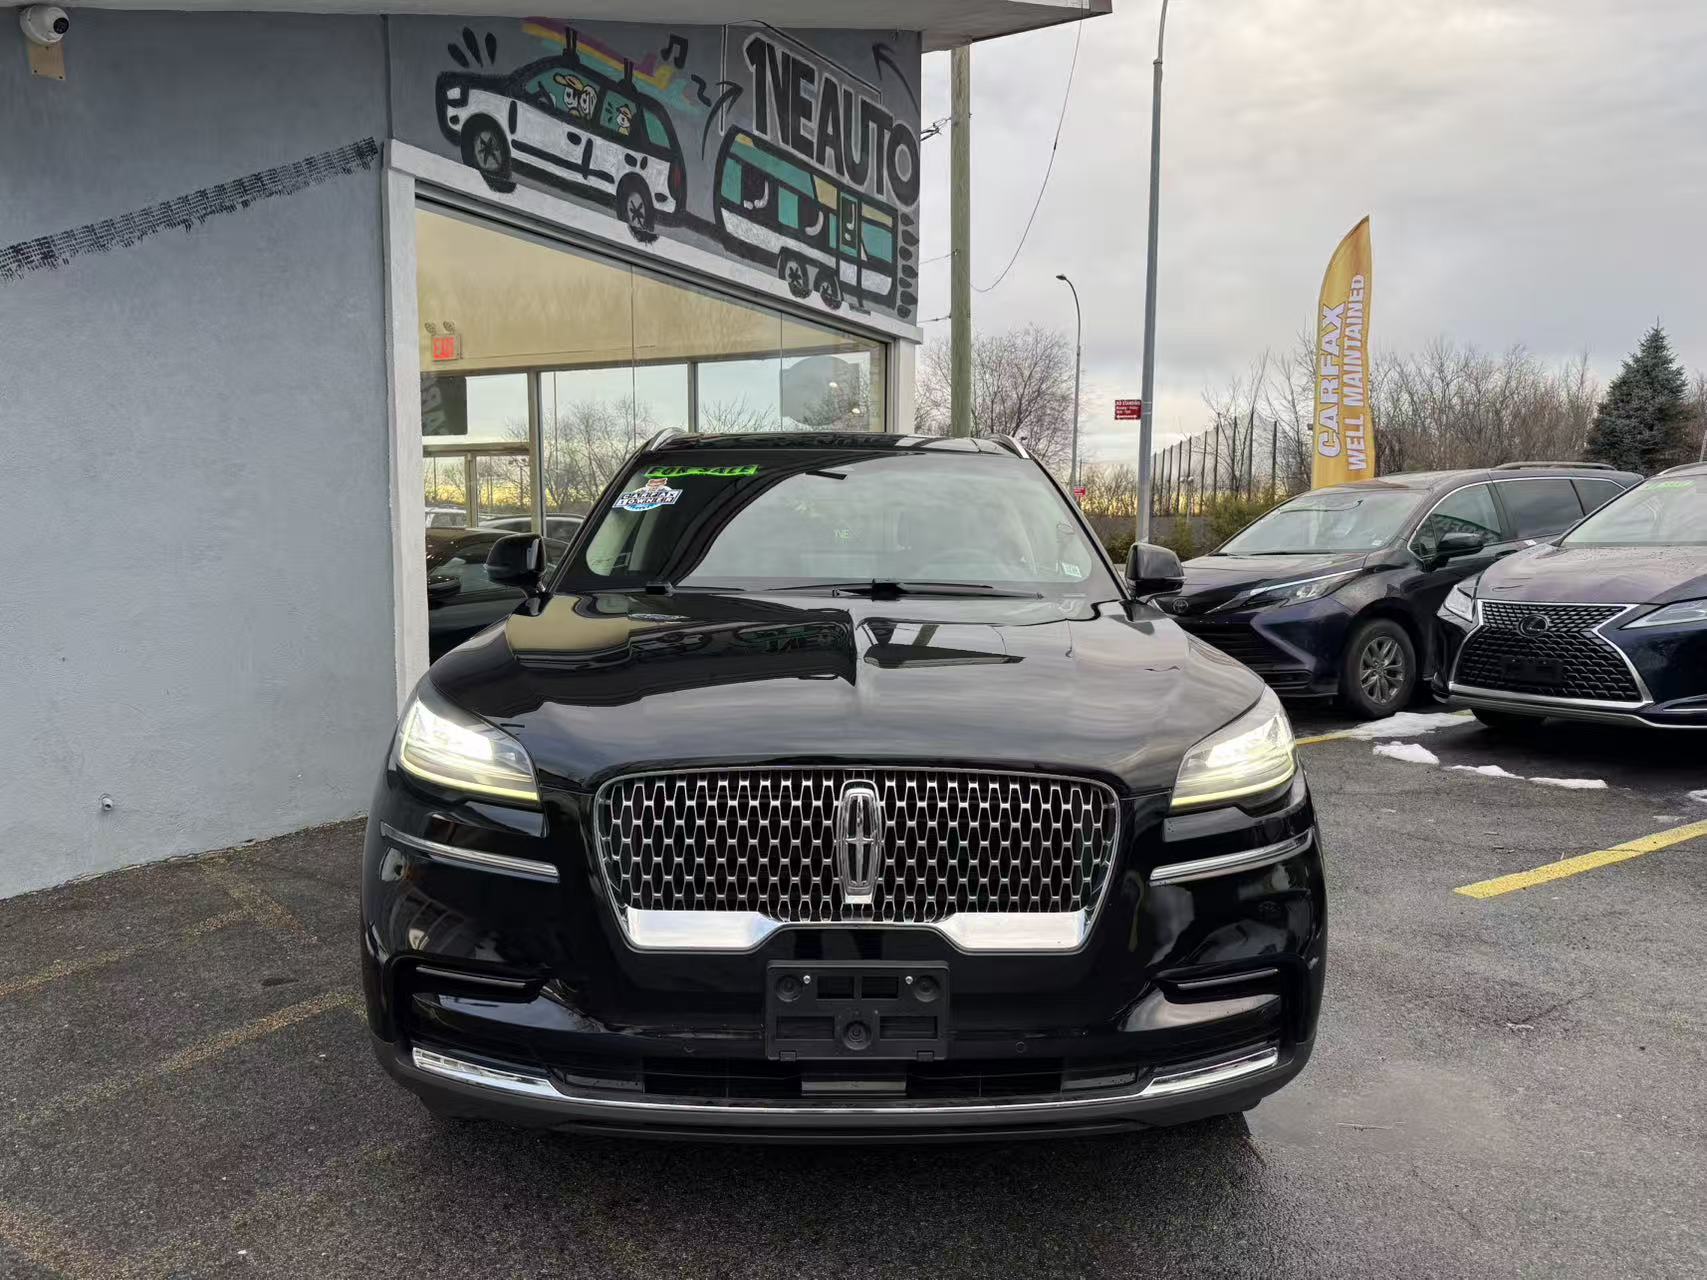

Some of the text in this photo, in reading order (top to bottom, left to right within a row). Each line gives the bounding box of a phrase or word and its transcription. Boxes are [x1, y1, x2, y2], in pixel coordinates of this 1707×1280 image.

[1318, 301, 1346, 457] CARFAX
[1343, 274, 1367, 471] WELL MAINTAINED
